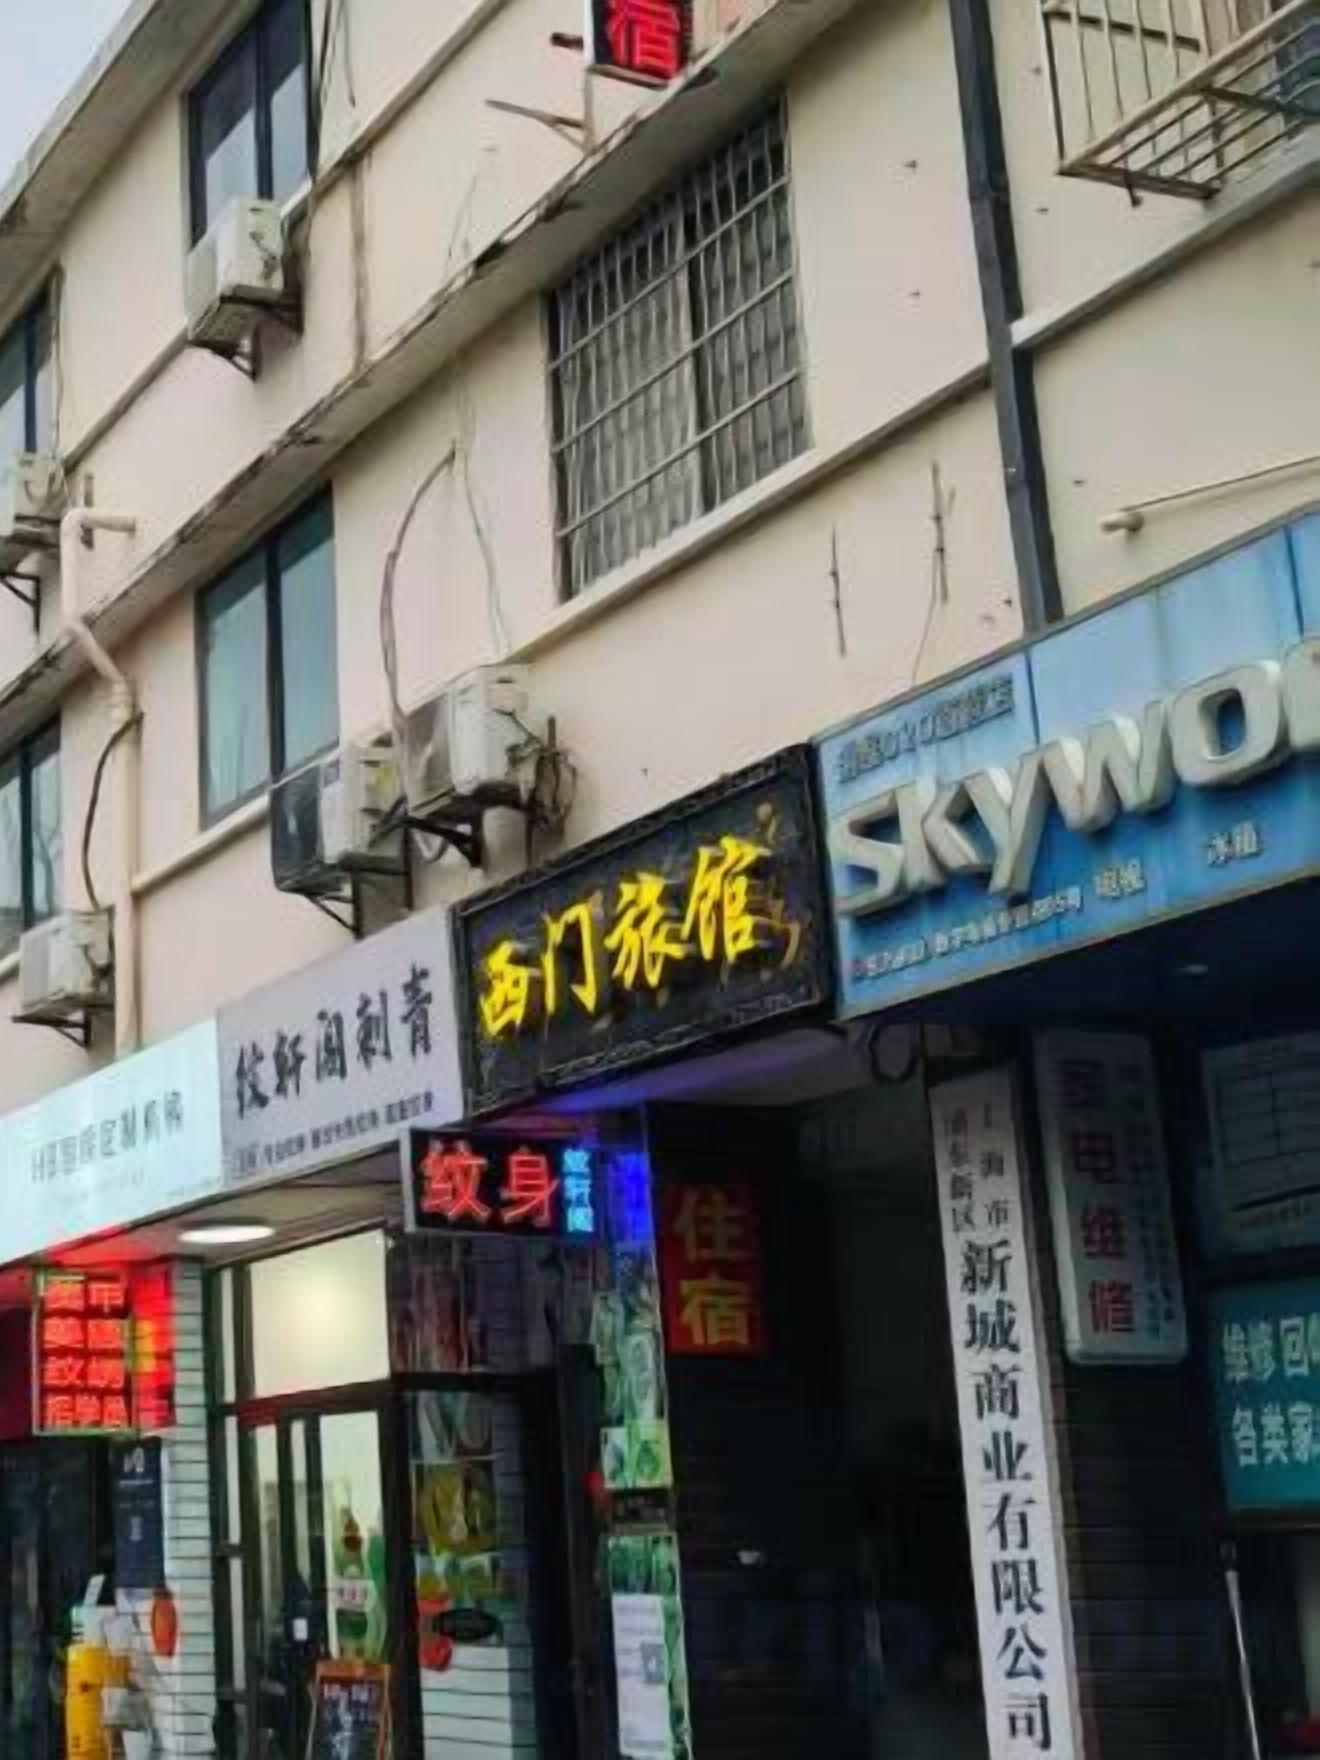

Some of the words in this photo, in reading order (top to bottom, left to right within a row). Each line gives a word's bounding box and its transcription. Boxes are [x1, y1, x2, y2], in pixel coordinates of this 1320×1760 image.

[481, 835, 772, 1040] 西门旅馆
[420, 1139, 560, 1226] 纹身
[675, 1188, 758, 1346] 住宿
[960, 1240, 1052, 1752] 新城商业有限公司
